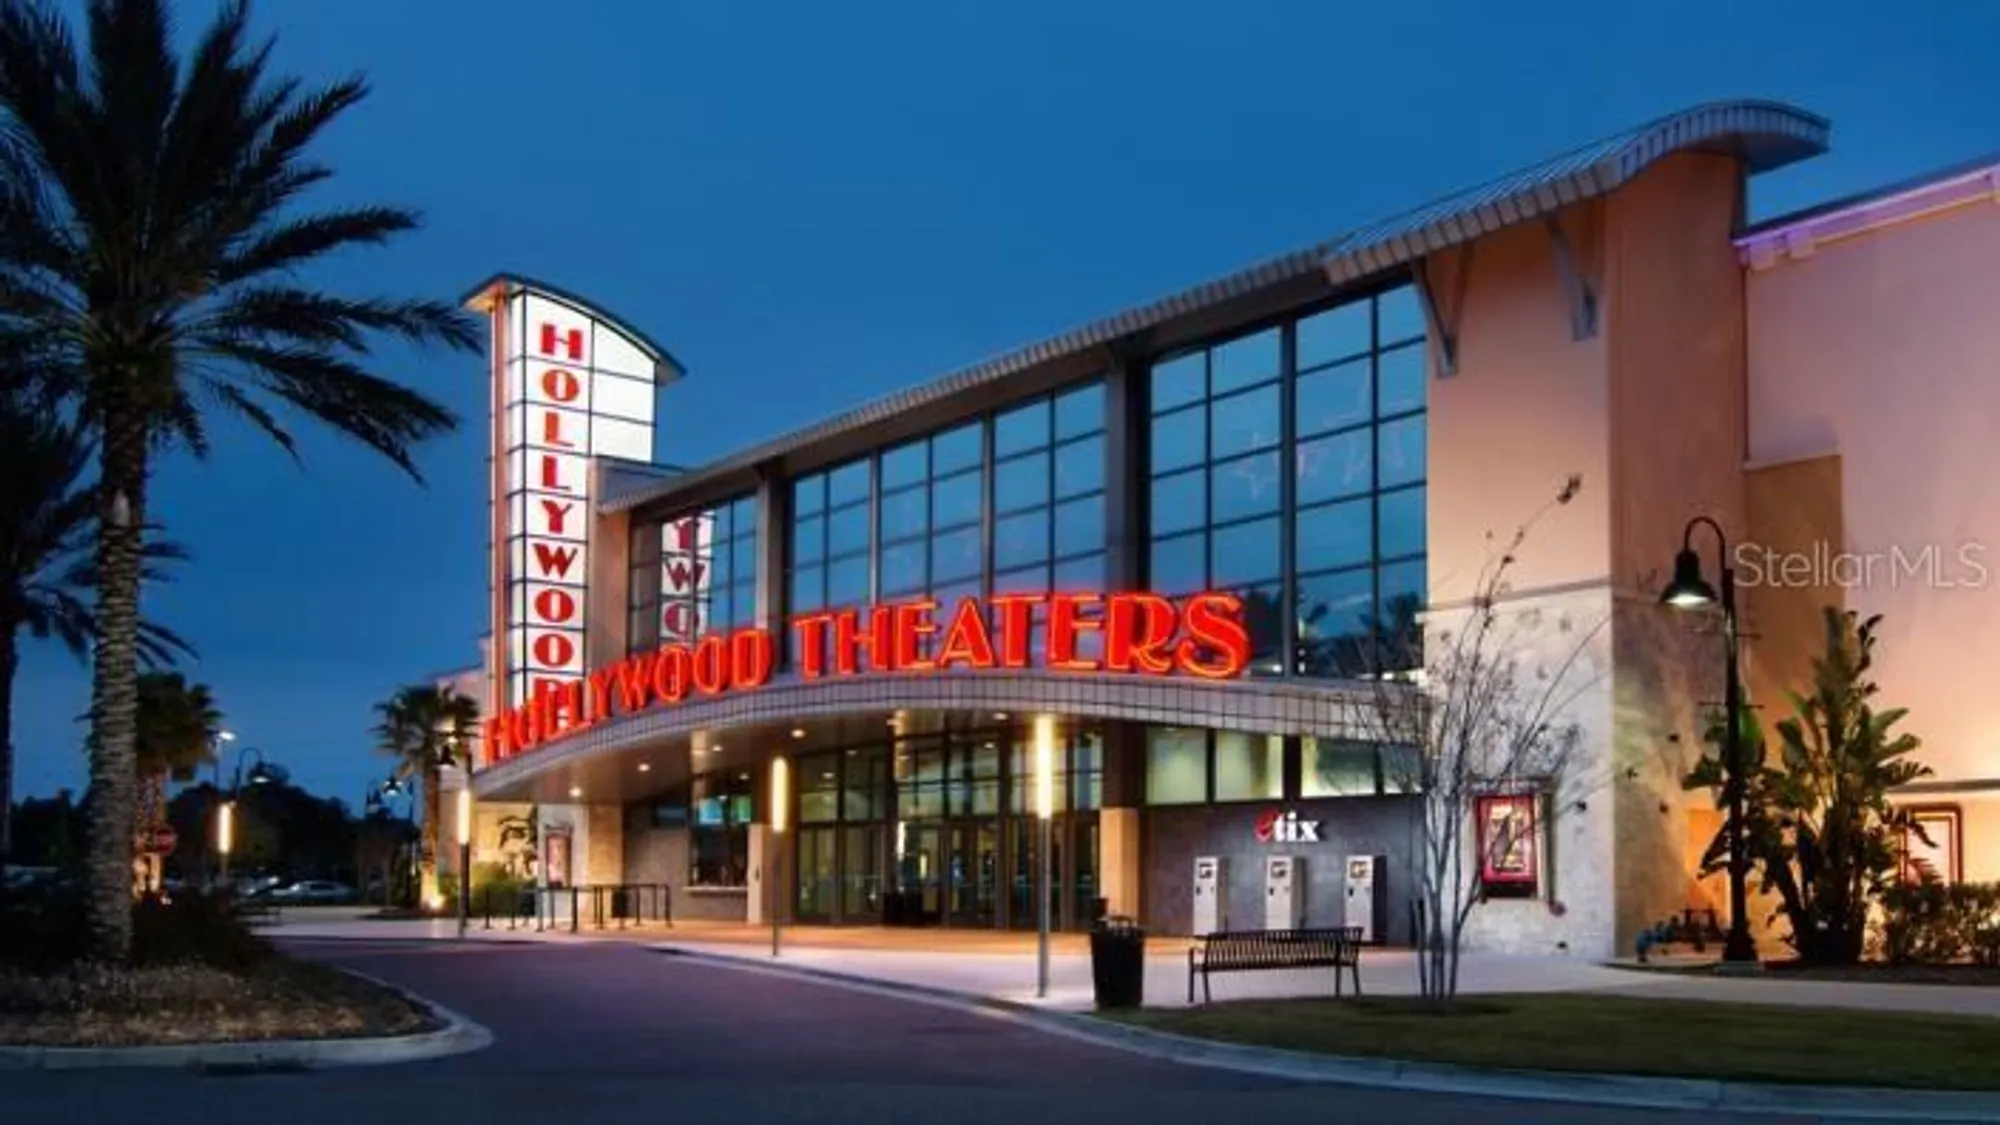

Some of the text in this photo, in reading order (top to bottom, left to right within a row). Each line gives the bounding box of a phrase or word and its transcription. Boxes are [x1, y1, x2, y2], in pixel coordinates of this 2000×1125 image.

[483, 591, 1250, 766] HOLLYWOOD THEATERS
[1253, 806, 1320, 845] etix
